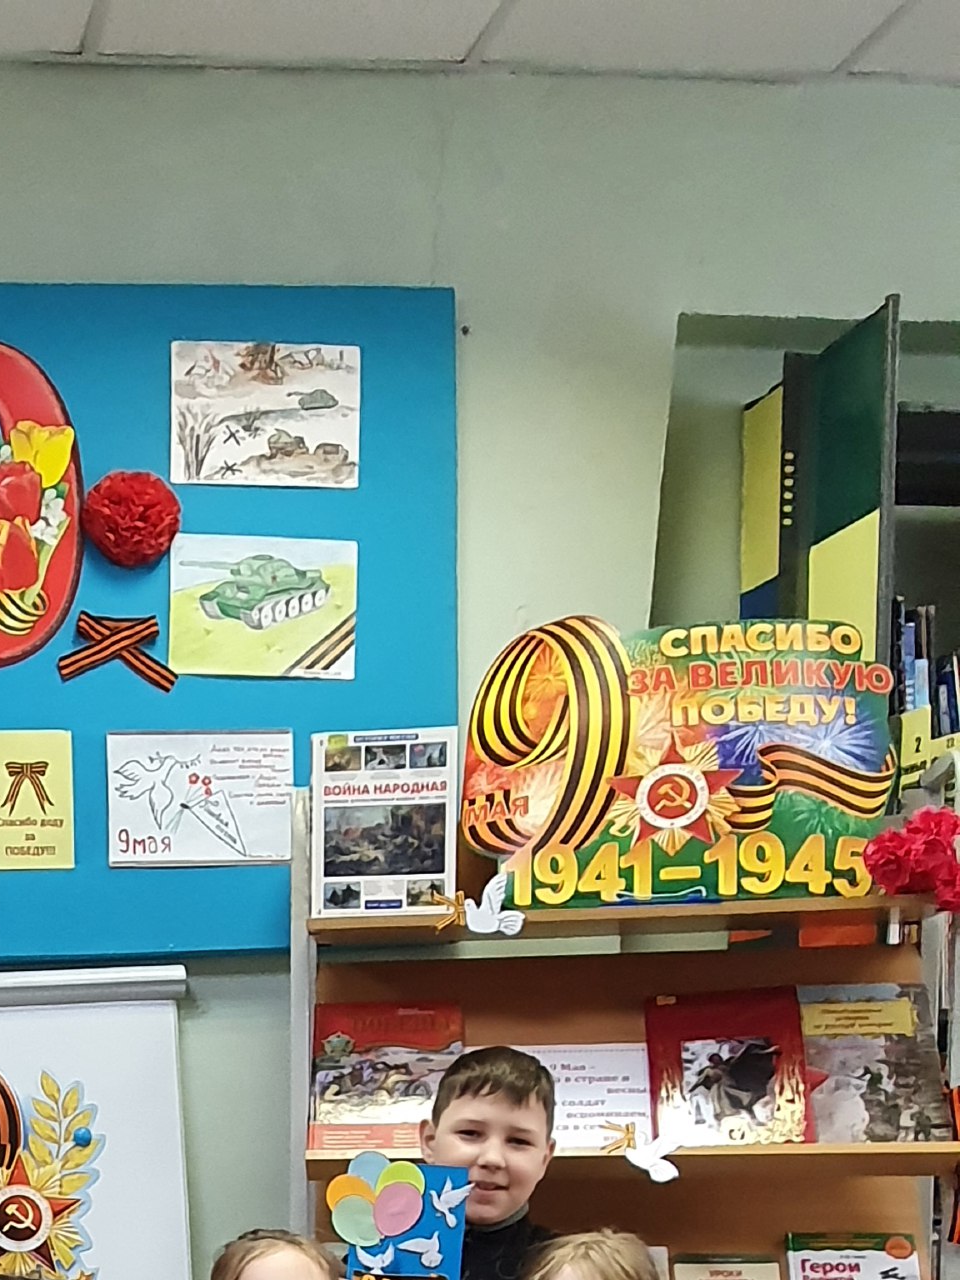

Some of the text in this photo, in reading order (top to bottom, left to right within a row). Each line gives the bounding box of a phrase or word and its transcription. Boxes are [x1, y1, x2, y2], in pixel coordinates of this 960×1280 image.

[659, 622, 863, 658] СПАСИБО
[629, 659, 893, 695] ЗА ВЕЛИКУЮ
[671, 694, 857, 728] ПОБЕДУ!
[323, 780, 447, 796] ВОЙНА НАРОДНАЯ
[464, 796, 529, 827] МАЯ
[801, 1259, 861, 1275] Герои
